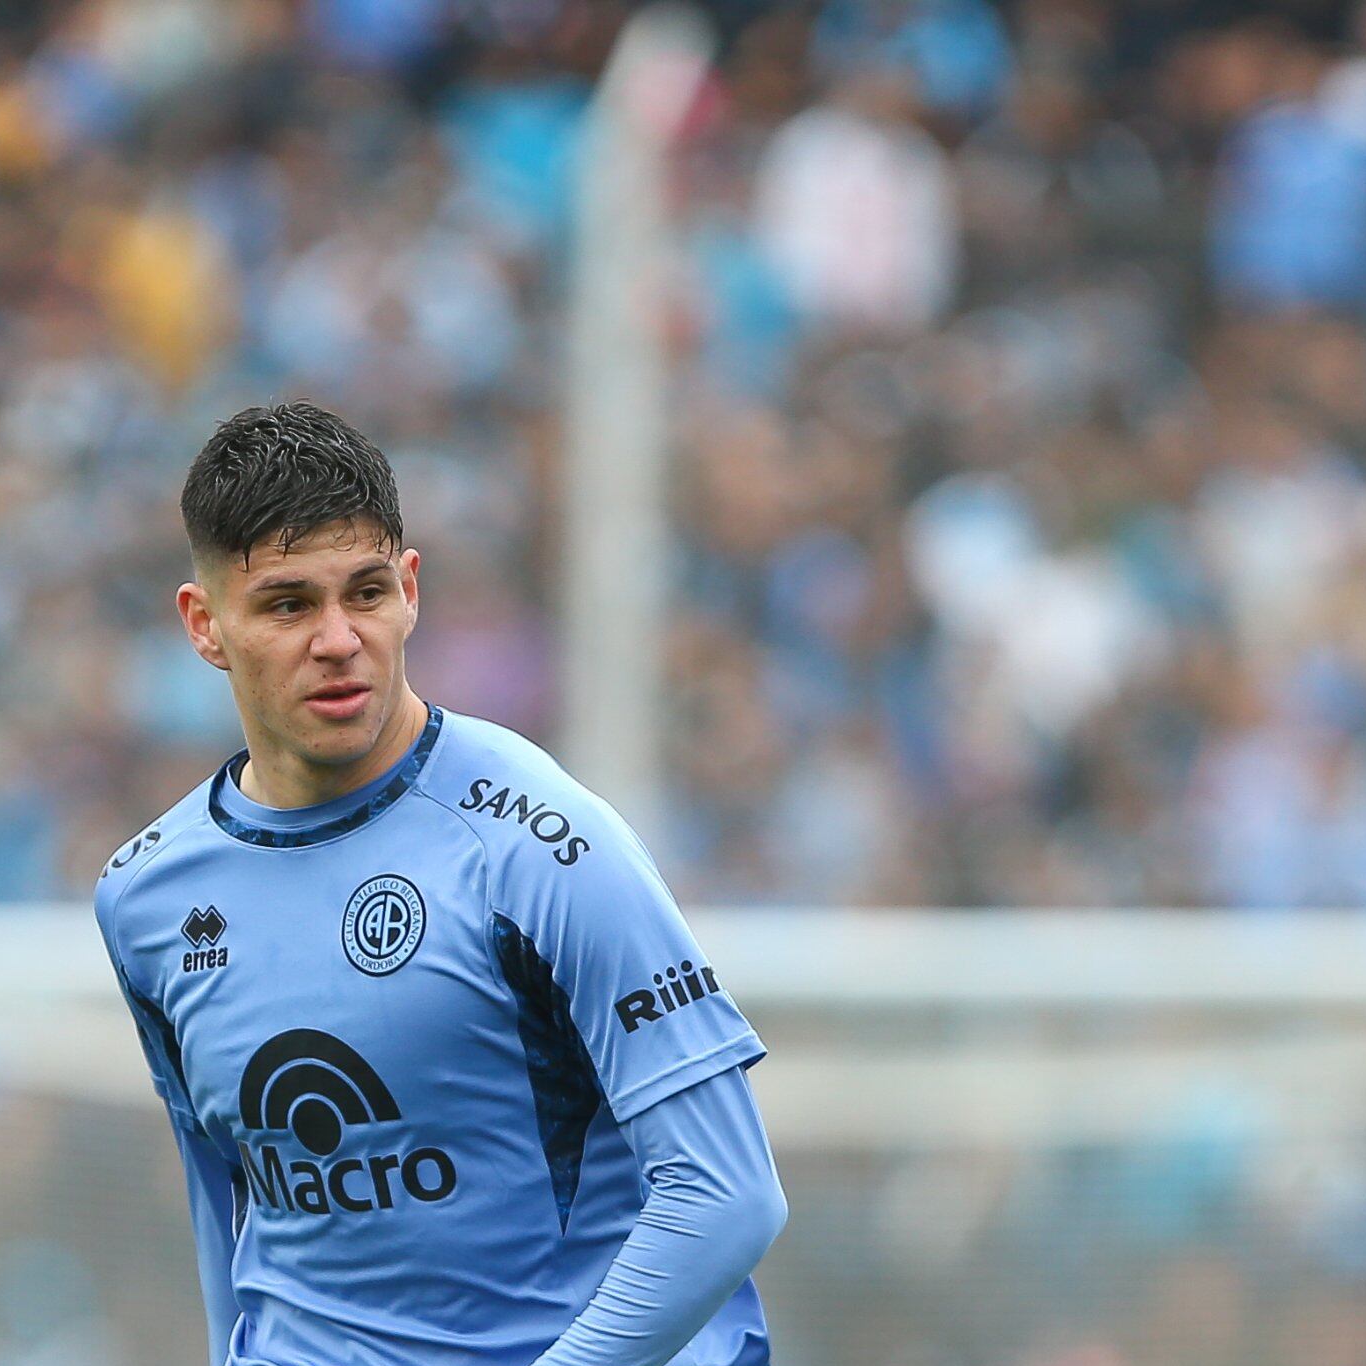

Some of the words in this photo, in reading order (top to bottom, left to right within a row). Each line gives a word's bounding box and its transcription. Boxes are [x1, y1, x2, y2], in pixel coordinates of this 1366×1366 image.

[459, 779, 590, 866] SANOS
[182, 946, 228, 972] errea
[237, 1141, 457, 1215] Macro
